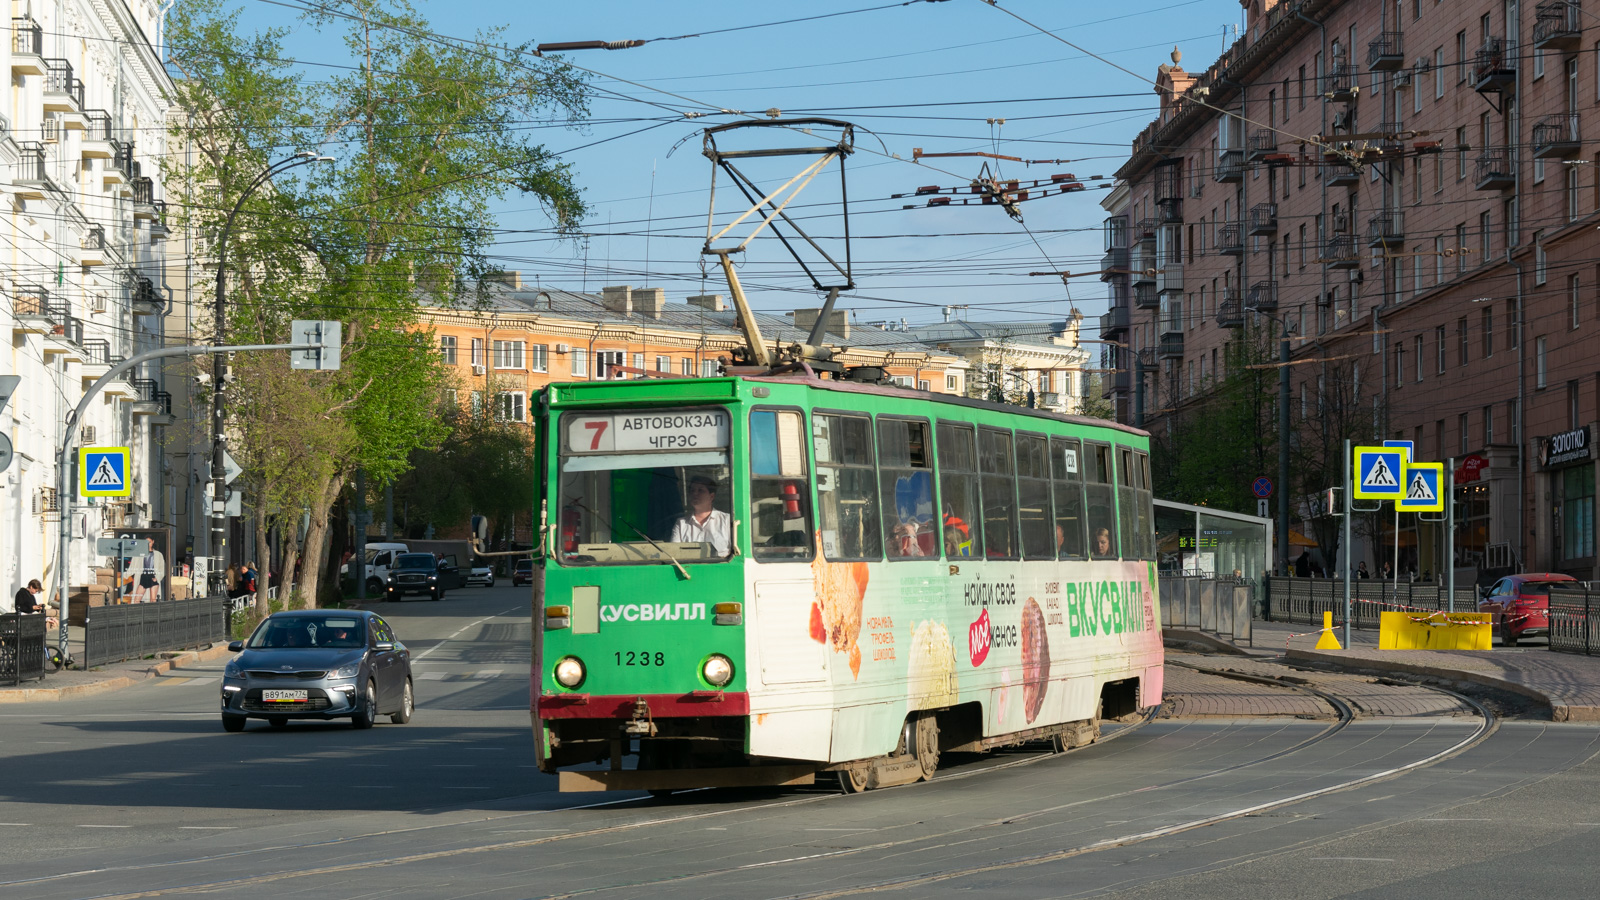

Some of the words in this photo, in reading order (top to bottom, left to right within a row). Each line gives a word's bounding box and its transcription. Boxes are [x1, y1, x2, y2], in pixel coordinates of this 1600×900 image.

[584, 421, 608, 450] 7
[622, 415, 723, 431] АВТОВОКЗАЛ
[649, 435, 697, 448] ЧГРЭС
[1552, 429, 1585, 455] ЗОЛОТКО
[995, 574, 1016, 605] своё
[1066, 580, 1145, 638] ВКУСВИЛЛ
[614, 651, 665, 667] 1238
